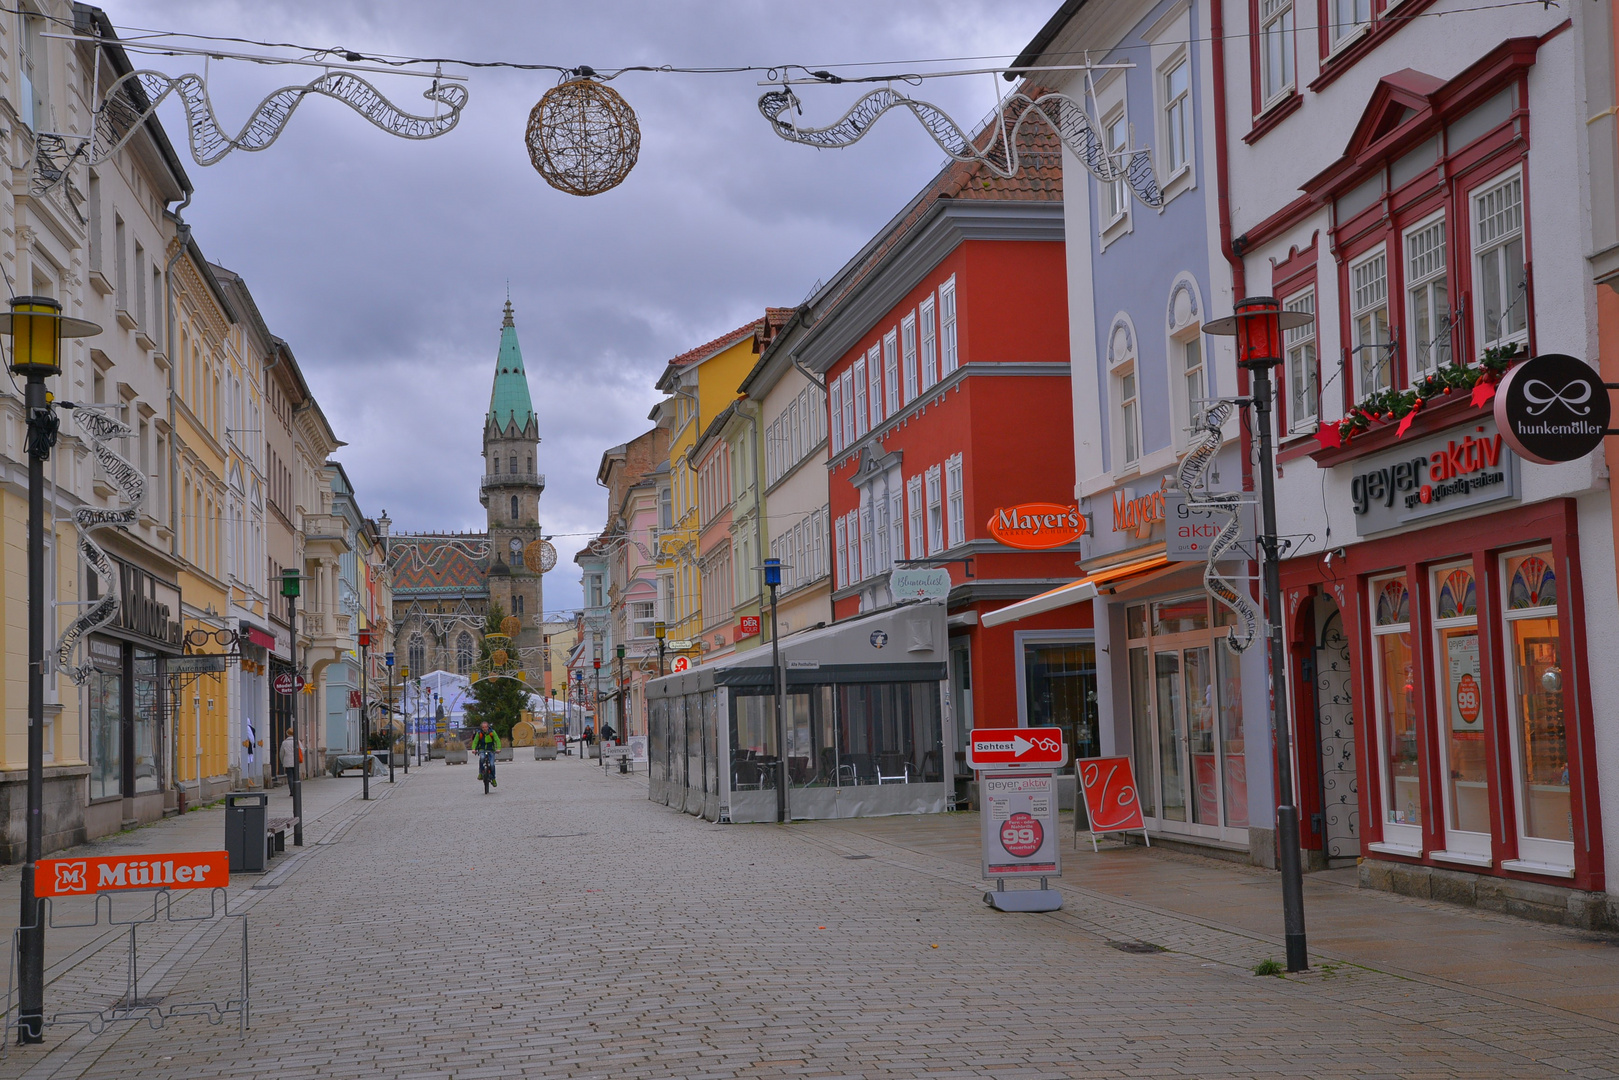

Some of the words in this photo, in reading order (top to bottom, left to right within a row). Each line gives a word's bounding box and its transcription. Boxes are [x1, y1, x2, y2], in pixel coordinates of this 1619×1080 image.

[1517, 420, 1603, 435] hunkemöller
[1351, 457, 1427, 515] geyer
[1429, 426, 1503, 482] aktiv
[1405, 492, 1421, 508] gut
[743, 619, 758, 627] DER
[976, 743, 1015, 751] Sehtest
[988, 780, 1019, 791] geyer
[1022, 779, 1048, 787] aktiv
[97, 860, 211, 887] Müller
